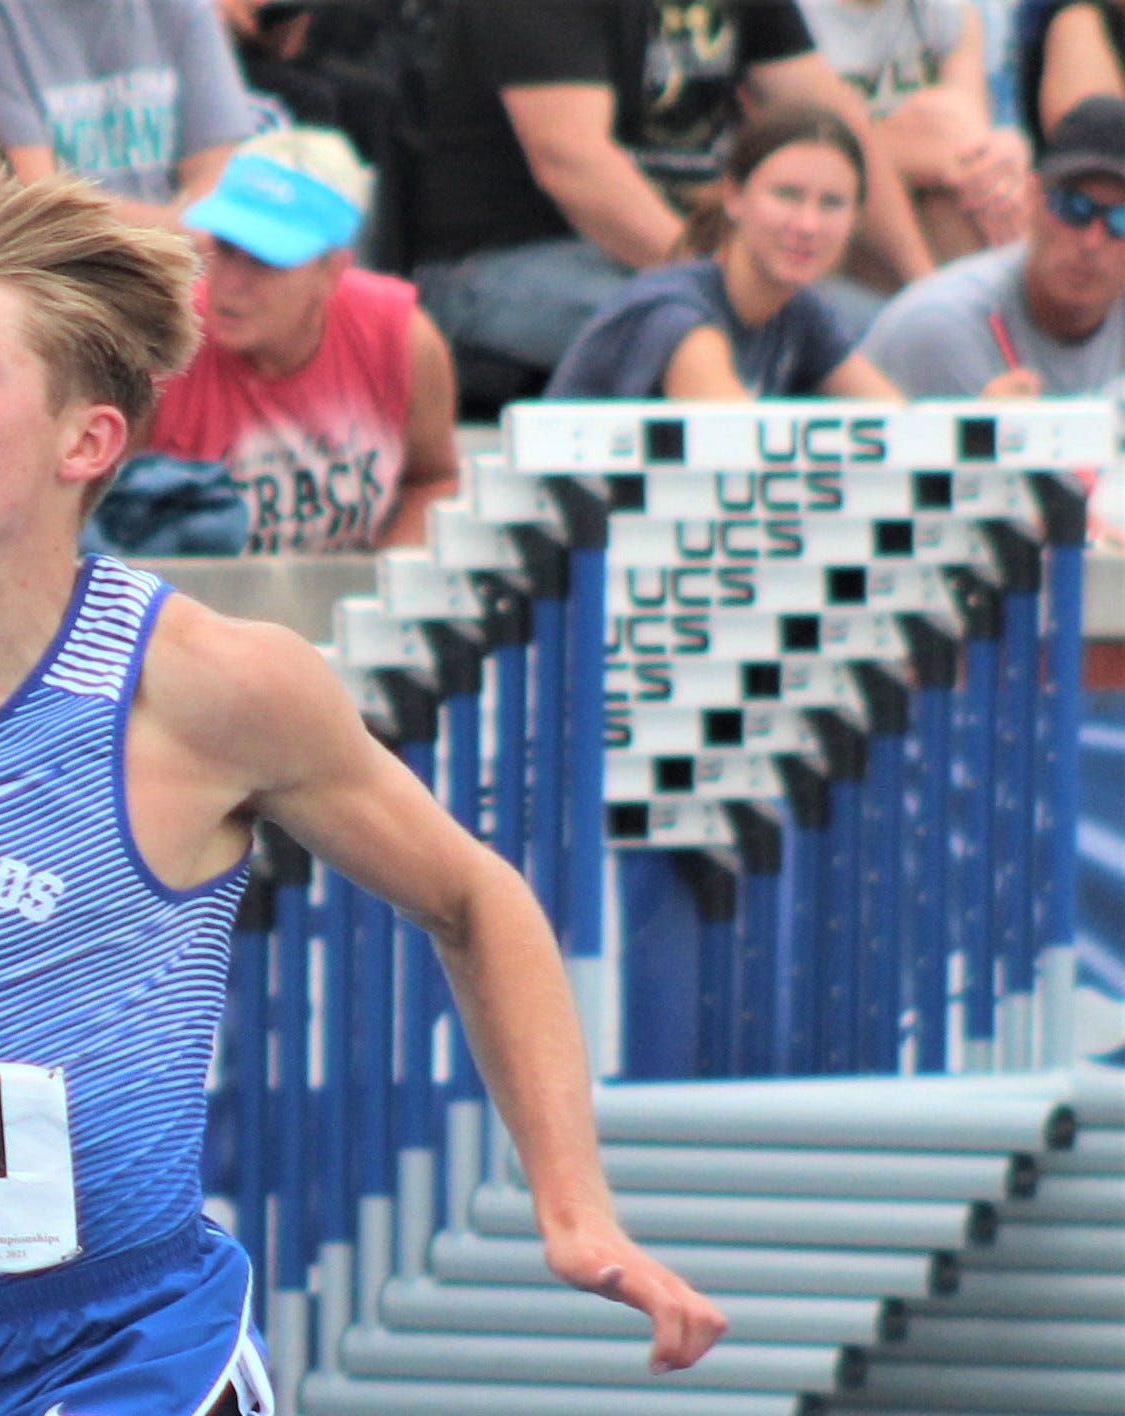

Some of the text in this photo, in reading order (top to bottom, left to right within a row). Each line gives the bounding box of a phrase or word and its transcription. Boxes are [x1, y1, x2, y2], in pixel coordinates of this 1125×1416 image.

[758, 418, 887, 463] UCS
[715, 471, 844, 513] UCS
[675, 520, 804, 561] UCS
[627, 567, 757, 608] UCS
